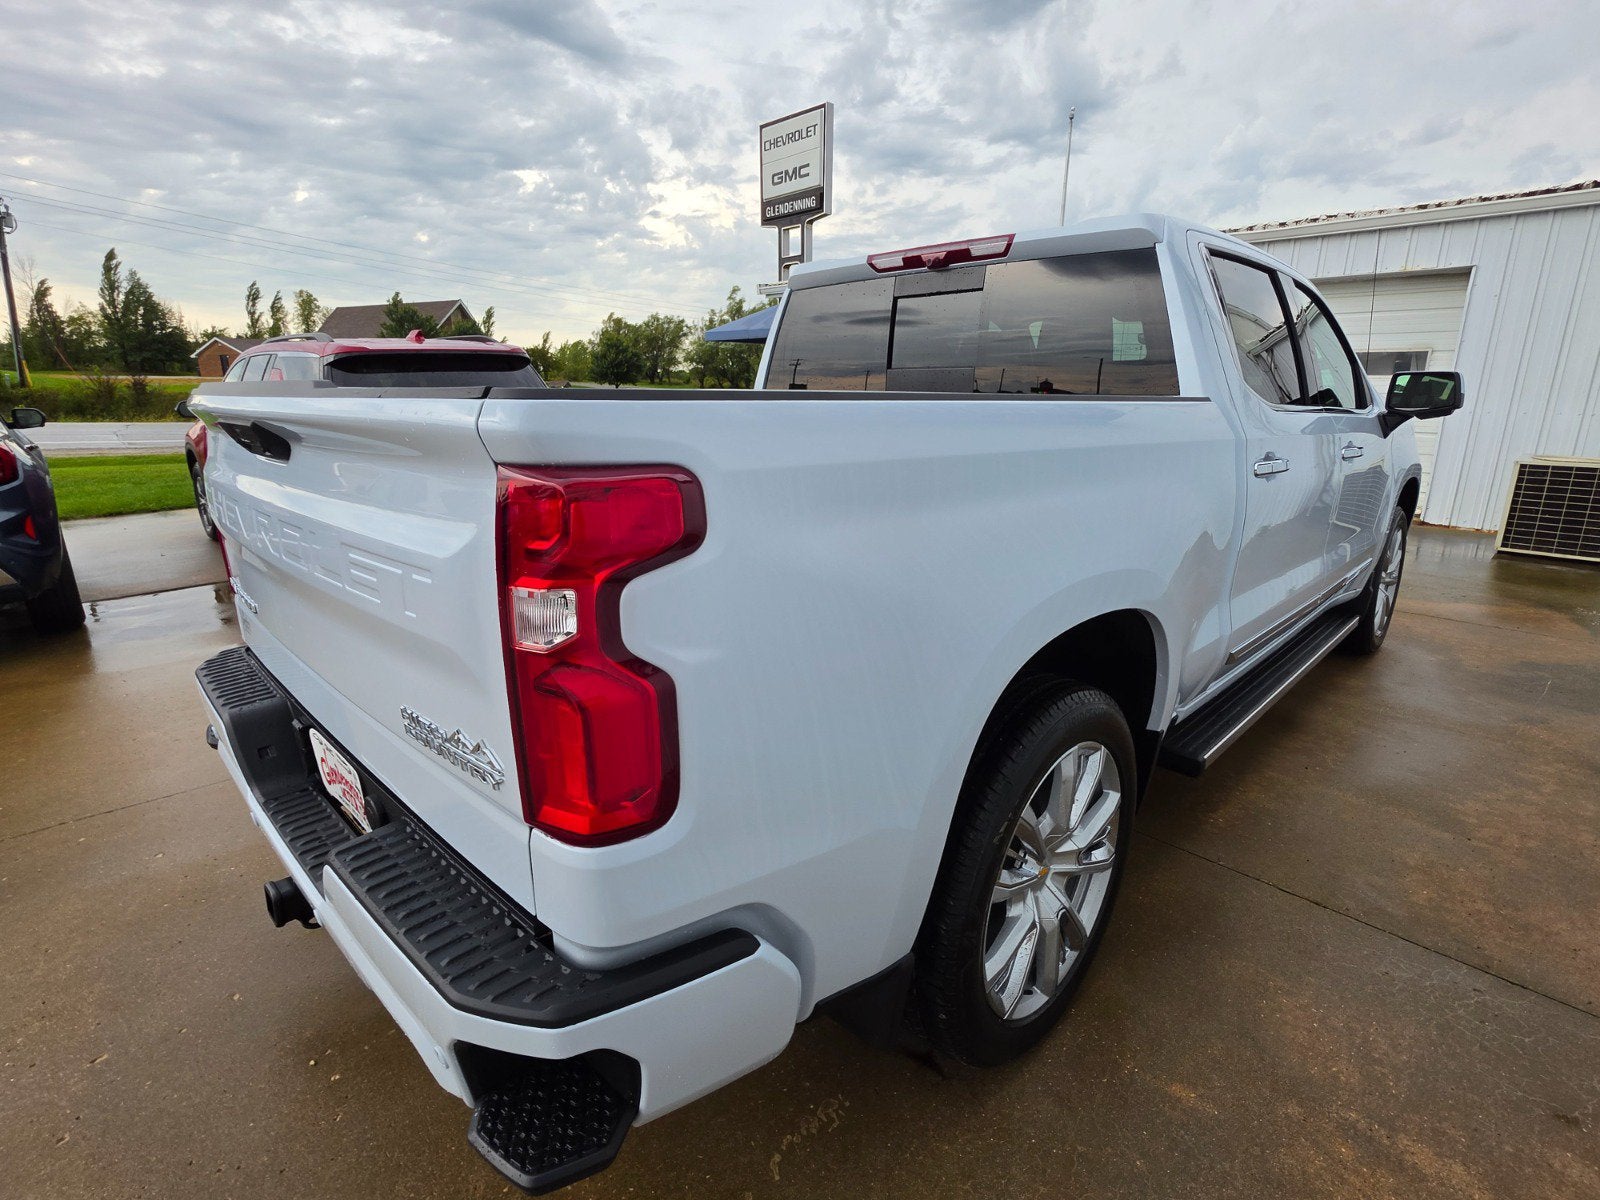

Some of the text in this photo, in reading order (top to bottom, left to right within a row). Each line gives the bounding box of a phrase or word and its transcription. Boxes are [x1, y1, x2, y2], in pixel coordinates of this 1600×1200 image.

[763, 123, 819, 152] CHEVROLET
[771, 162, 810, 187] GMC
[765, 196, 816, 218] GLENDENNING
[404, 722, 505, 791] COUNTRY
